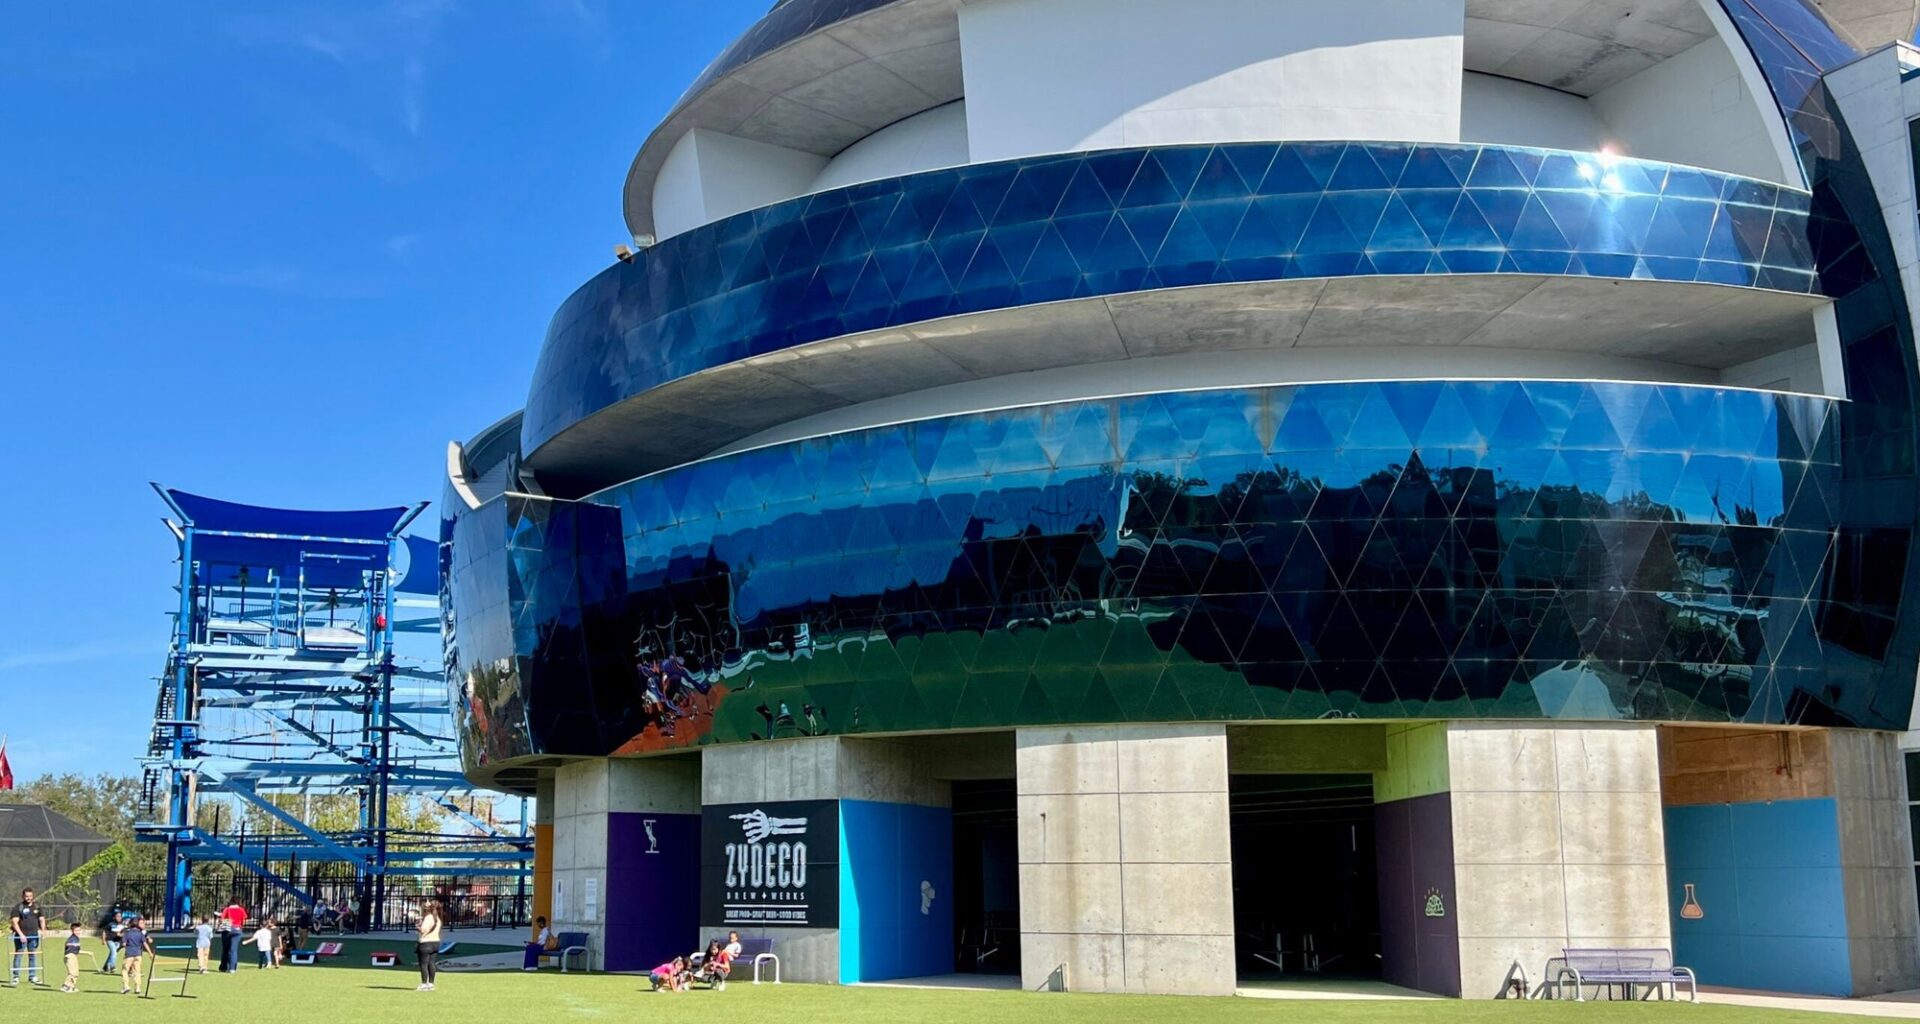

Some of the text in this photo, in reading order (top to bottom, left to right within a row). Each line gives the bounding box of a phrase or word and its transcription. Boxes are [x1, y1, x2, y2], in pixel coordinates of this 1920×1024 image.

[725, 841, 807, 889] ZYDECO
[726, 891, 805, 900] BREW WERKS
